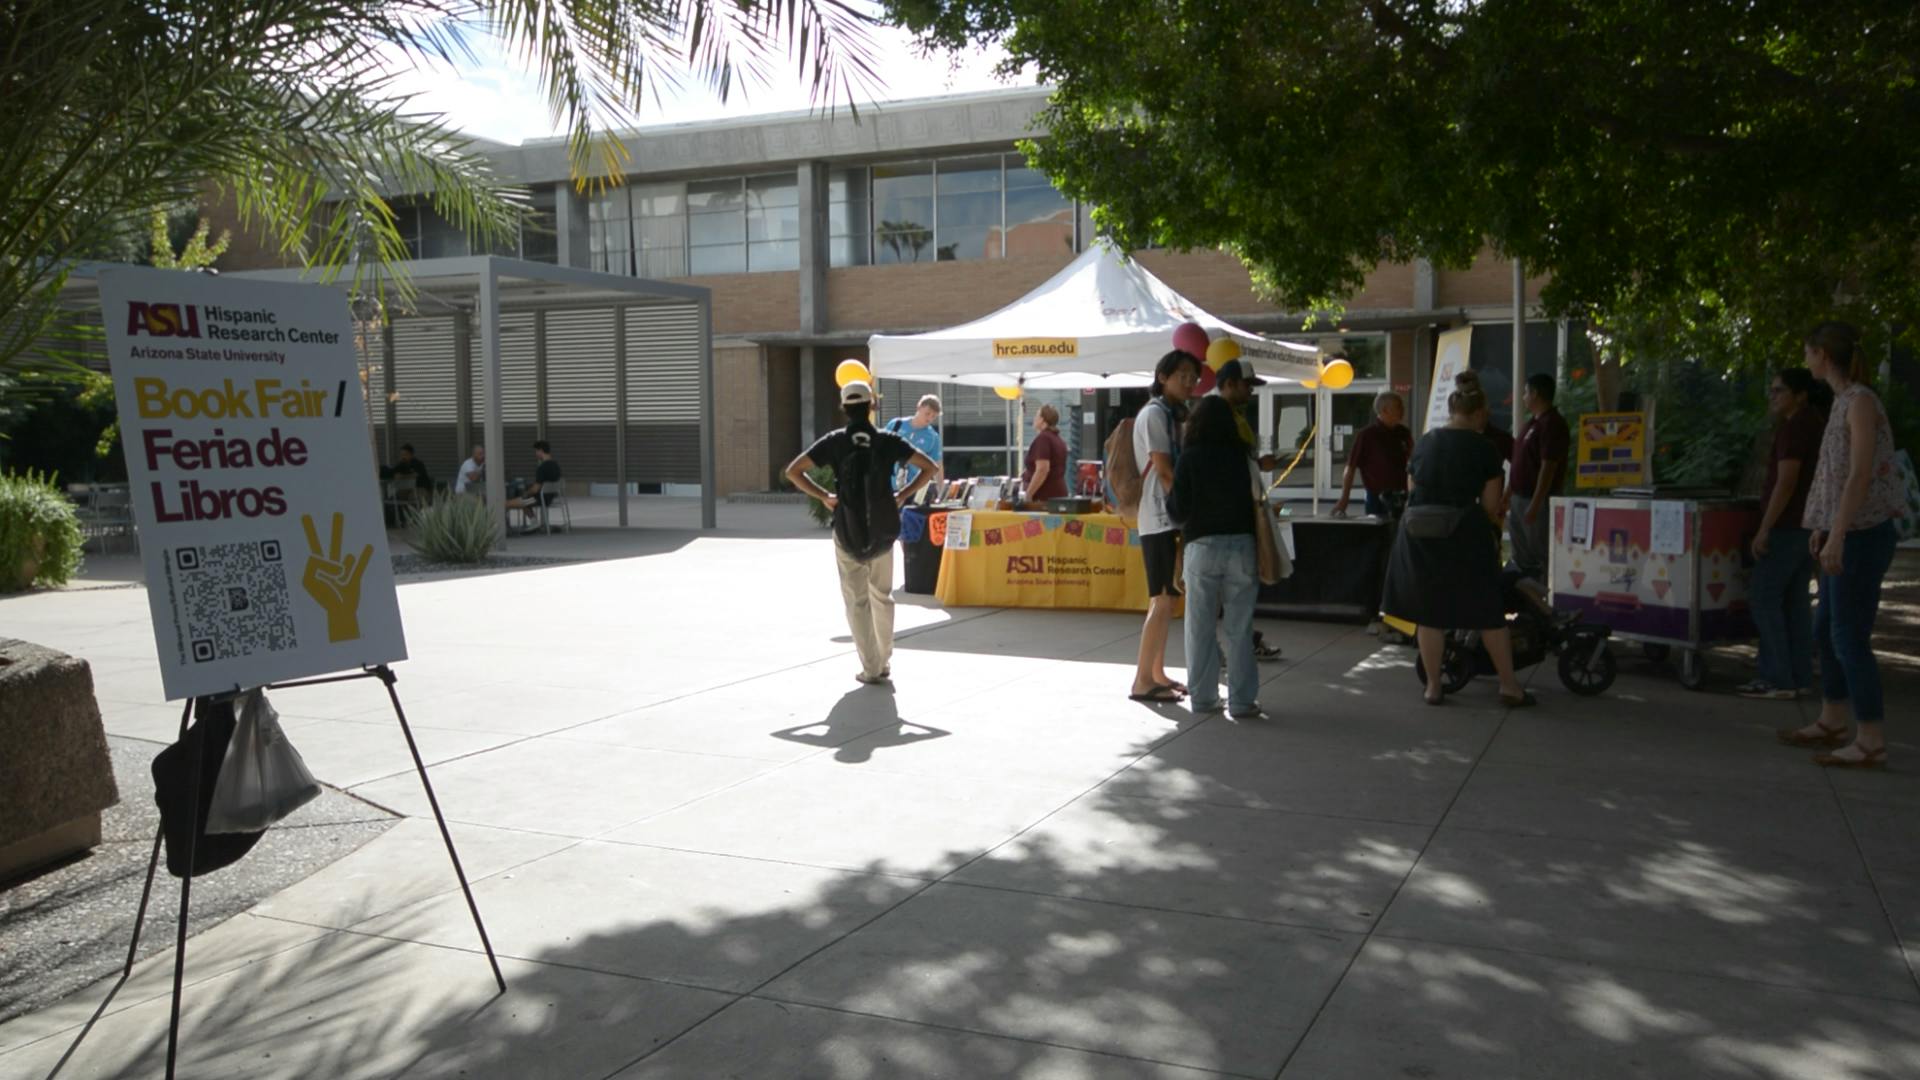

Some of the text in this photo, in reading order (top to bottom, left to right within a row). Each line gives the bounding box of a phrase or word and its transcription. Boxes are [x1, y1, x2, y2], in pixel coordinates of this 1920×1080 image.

[127, 301, 201, 338] ASU
[204, 305, 277, 325] Hispanic
[207, 324, 340, 345] Research Center
[130, 346, 286, 365] Arizona State University
[996, 341, 1075, 356] hrc.asu.edu
[134, 377, 347, 419] Book Fair /
[142, 427, 308, 472] Feria de
[151, 480, 288, 523] Libros
[1006, 556, 1044, 574] ASU
[1047, 556, 1088, 565] Hispanic
[1047, 565, 1126, 576] Research Center
